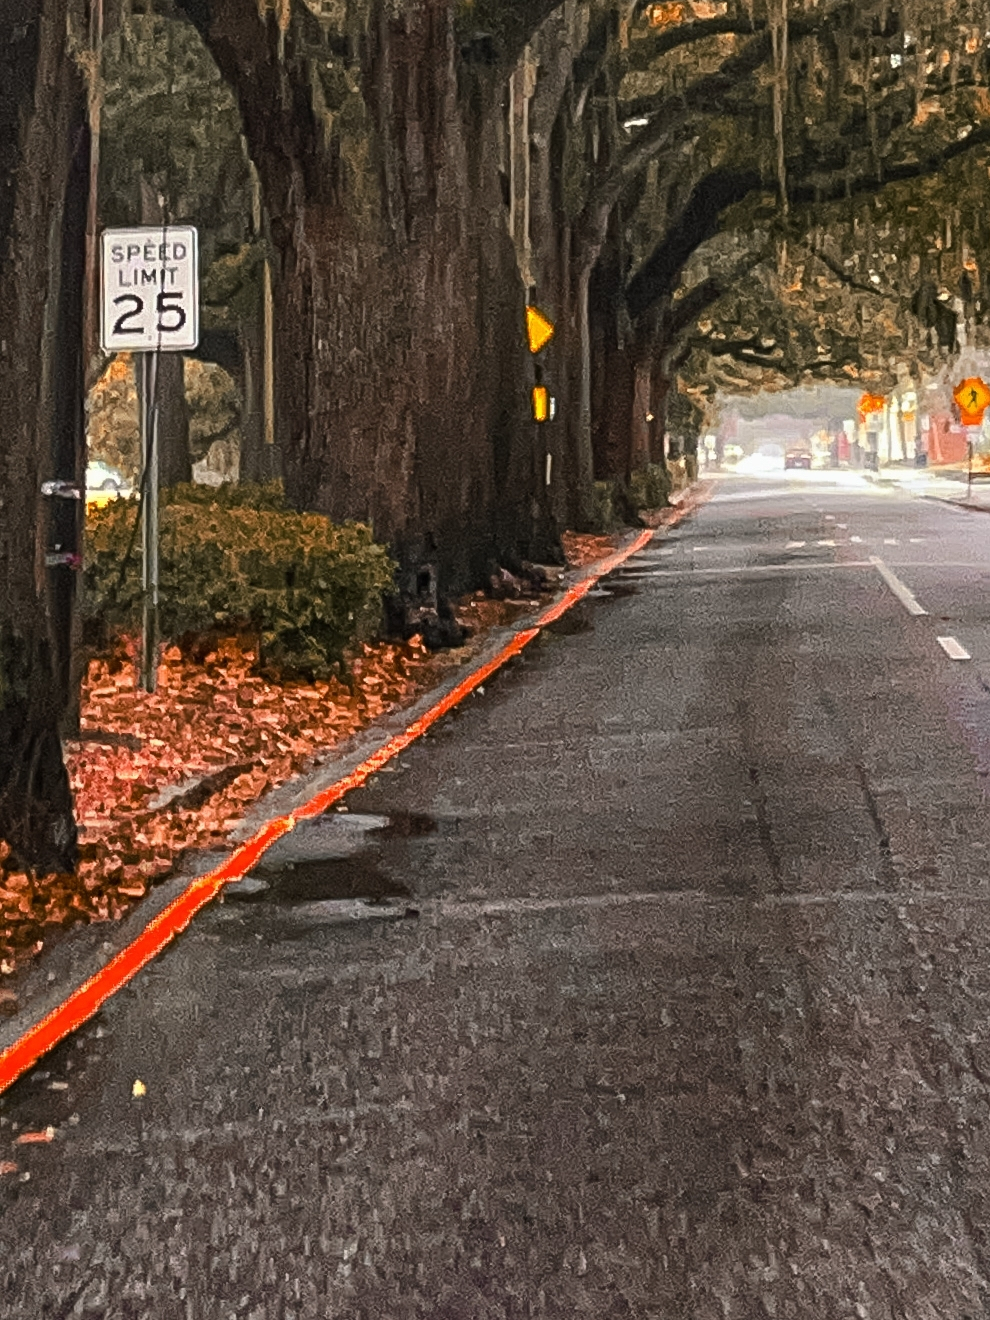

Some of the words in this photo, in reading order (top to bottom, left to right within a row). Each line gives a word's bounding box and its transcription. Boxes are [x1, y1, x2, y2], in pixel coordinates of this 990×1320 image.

[111, 242, 187, 262] SPEED
[118, 267, 178, 287] LIMIT
[112, 292, 187, 334] 25
